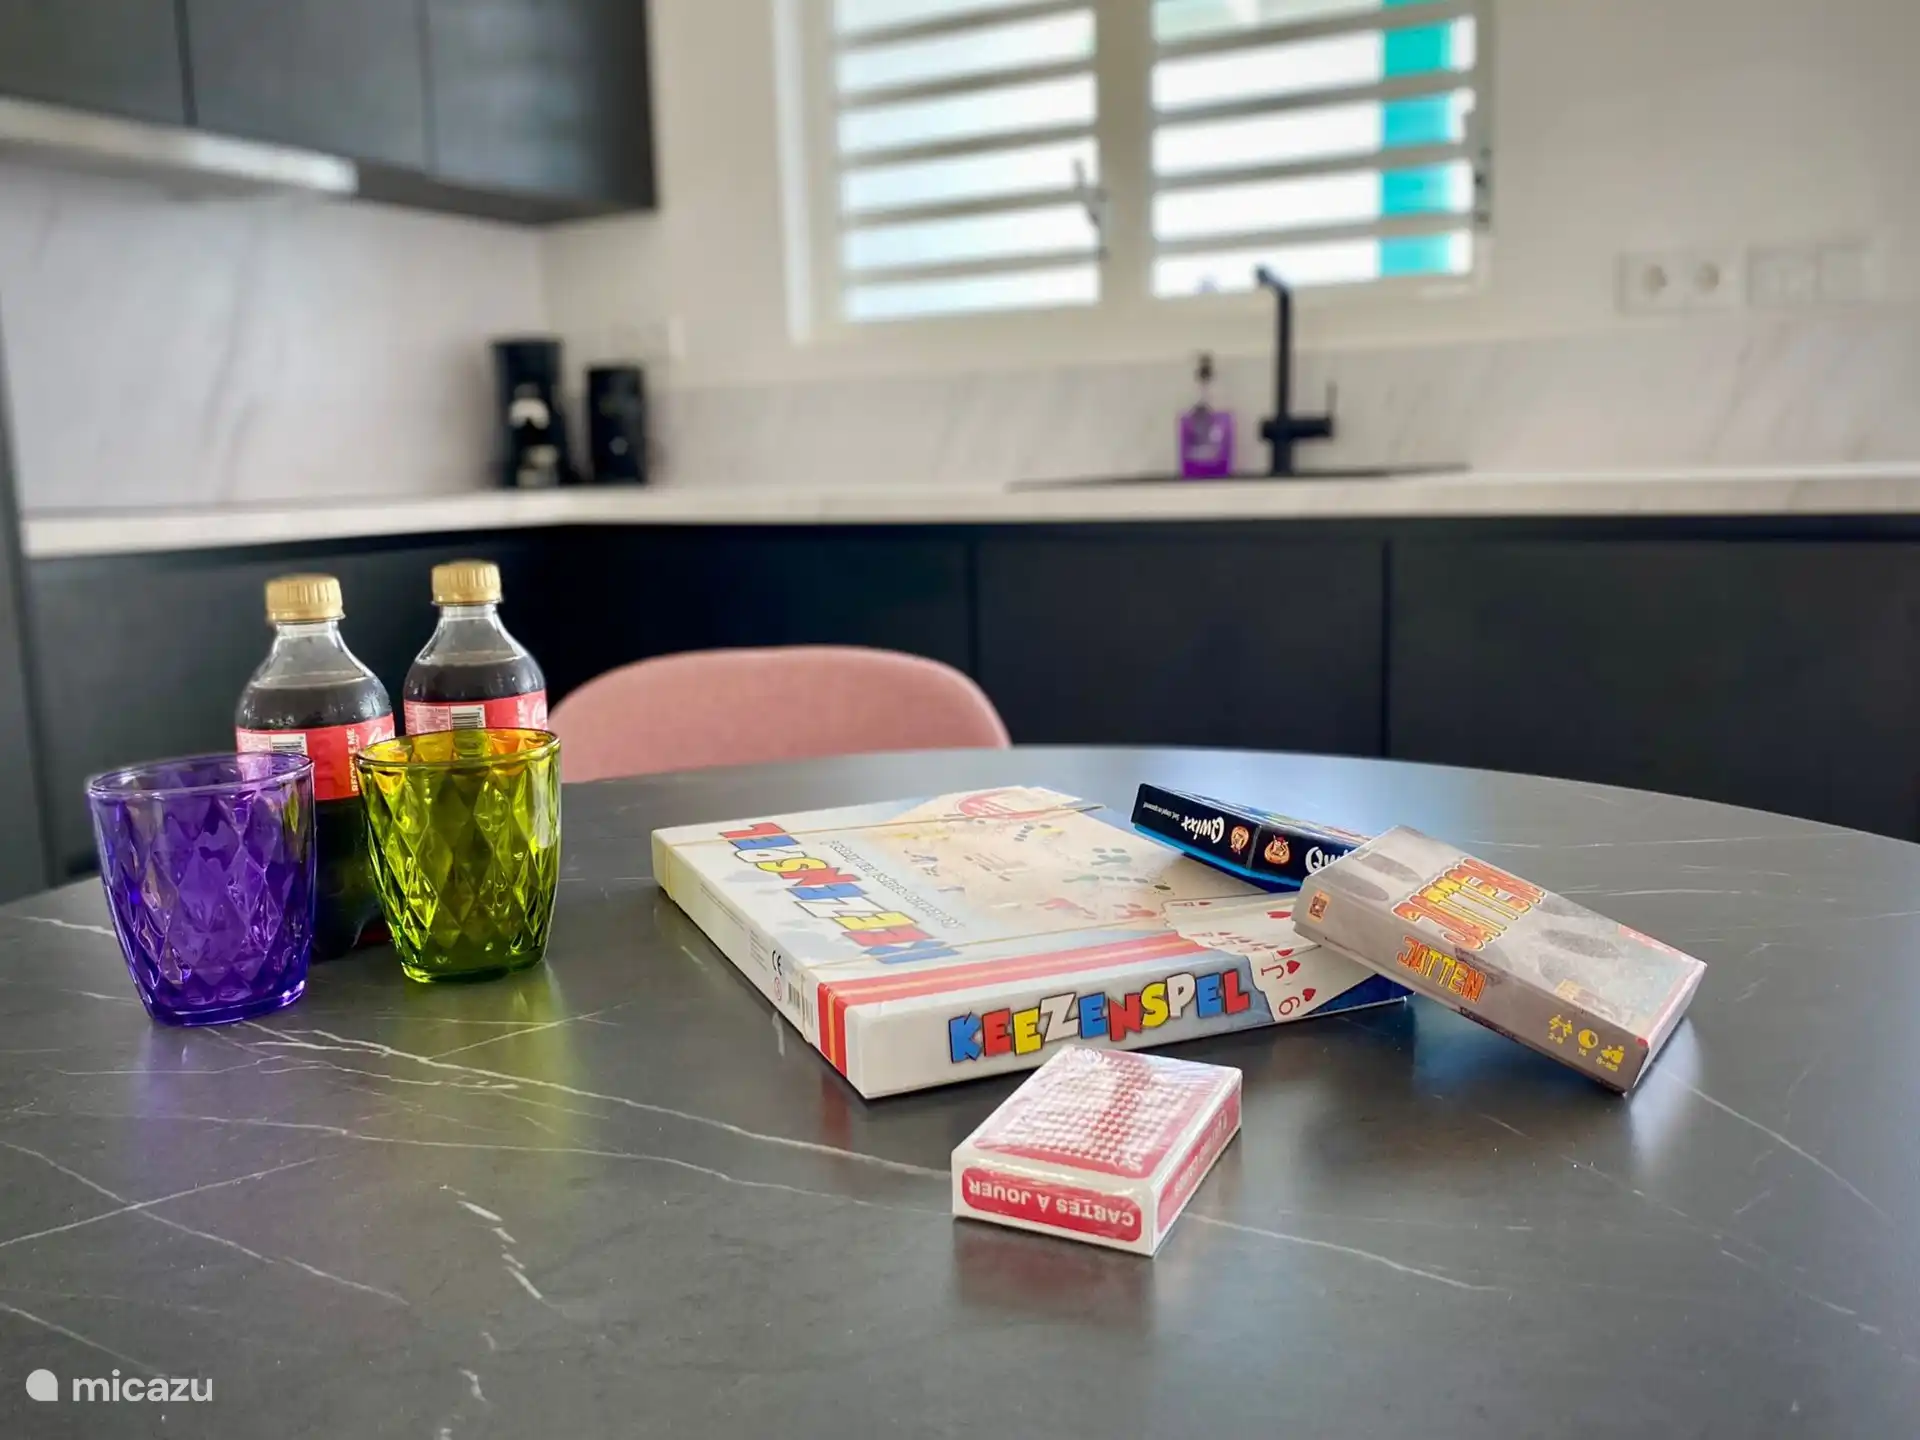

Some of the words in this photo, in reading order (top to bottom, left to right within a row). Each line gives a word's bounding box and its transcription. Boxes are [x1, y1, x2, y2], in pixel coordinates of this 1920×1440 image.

[1181, 815, 1224, 844] Qwixx
[718, 822, 962, 965] KEEZENSPEL
[1392, 857, 1547, 951] JATTEN
[1397, 934, 1486, 1004] JATTEN
[948, 969, 1250, 1064] KEEZENSPEL
[968, 1180, 1031, 1205] JOUER
[1056, 1198, 1134, 1227] CARTES
